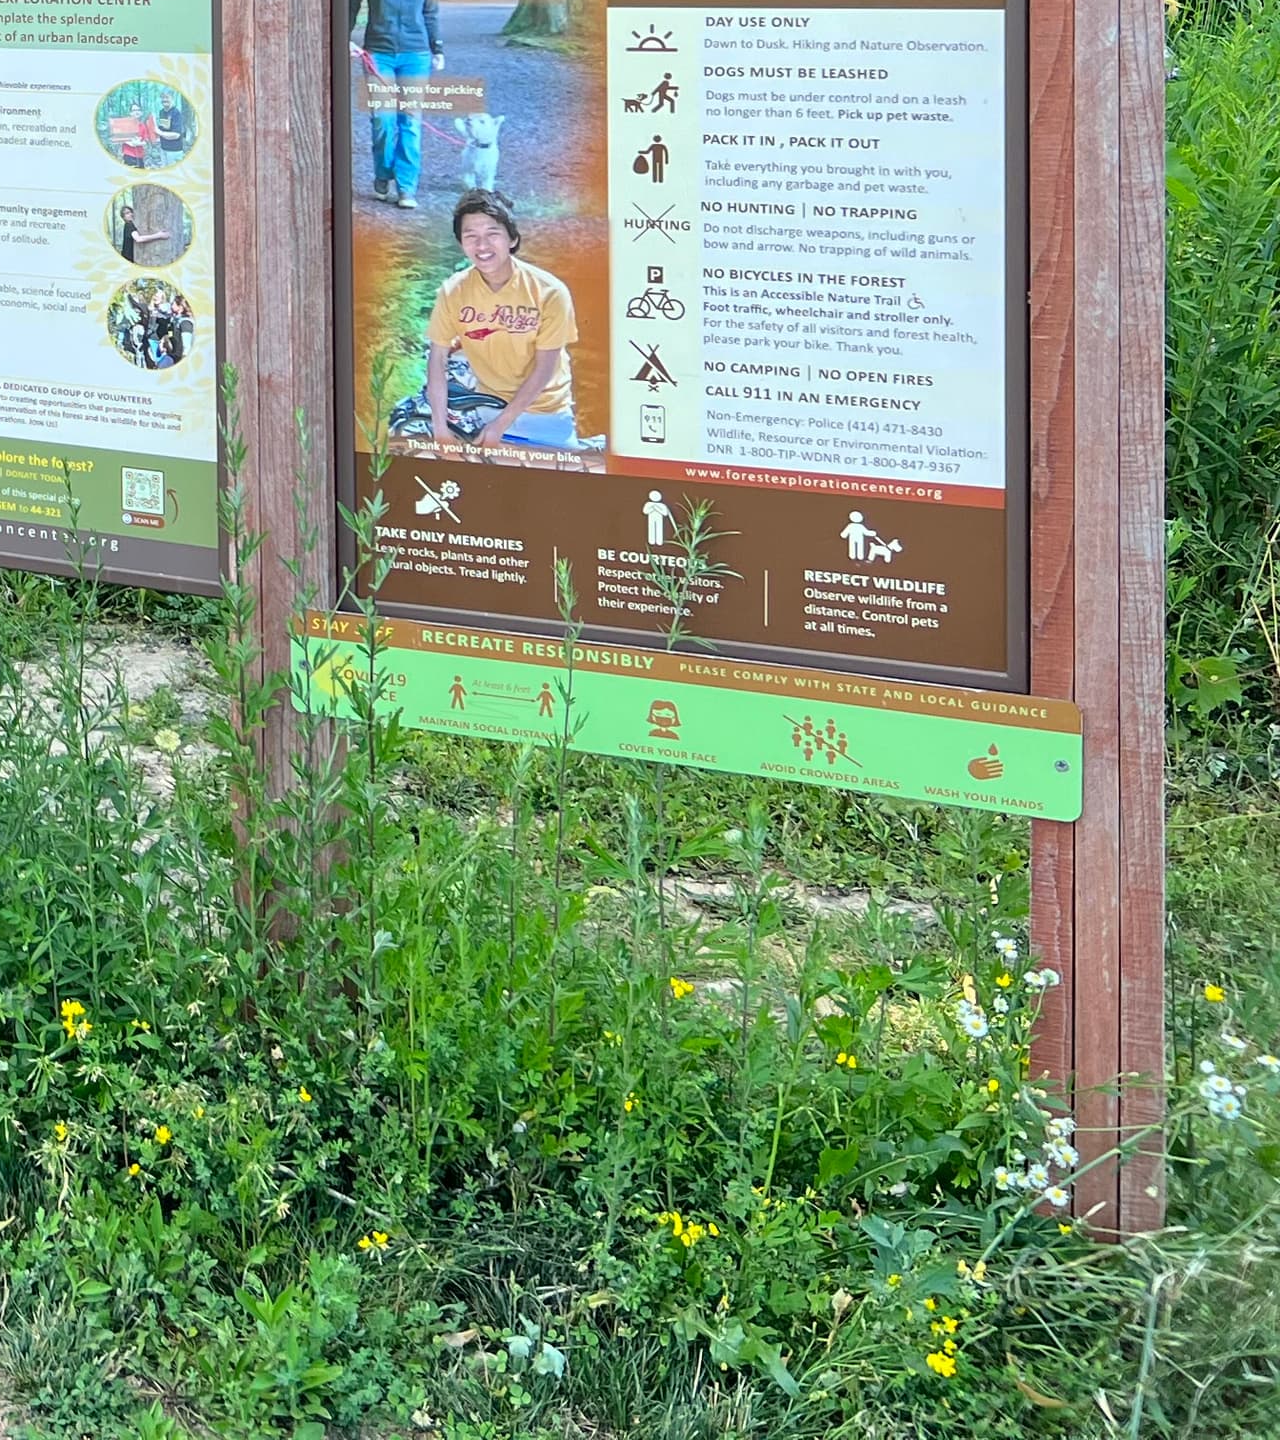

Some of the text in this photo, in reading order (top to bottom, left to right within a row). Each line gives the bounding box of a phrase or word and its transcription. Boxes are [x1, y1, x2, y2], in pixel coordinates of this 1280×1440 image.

[38, 14, 57, 24] the
[60, 14, 114, 26] splendor
[706, 17, 810, 28] DAY USE ONLY
[704, 67, 888, 80] DOGS MUST BE LEASHED
[703, 135, 738, 145] PACK
[743, 136, 755, 145] IT
[760, 136, 775, 146] IN
[790, 137, 826, 147] PACK
[831, 138, 843, 147] IT
[848, 139, 880, 149] OUT
[701, 202, 918, 220] NO HUNTING NO TRAPPING
[624, 219, 690, 231] HUNTING
[703, 269, 906, 288] NO BICYCLES IN THE FOREST
[459, 307, 486, 323] De
[704, 361, 933, 386] NO CAMPING NO OPEN FIRES
[705, 386, 920, 410] CALL 911 IN AN EMERGENCY
[29, 454, 48, 467] the
[685, 468, 942, 500] www.forestexplorationcenter.org
[375, 526, 523, 551] TAKE ONLY MEMORIES
[804, 570, 946, 595] RESPECT WILDLIFE
[422, 630, 514, 653] RECREATE
[679, 663, 1048, 719] PLEASE COMPLY WITH STATE AND LOCAL GUIDANCE
[760, 763, 900, 790] AVOID CROWDED AREAS
[924, 785, 1044, 811] WASH YOUR HANDS
